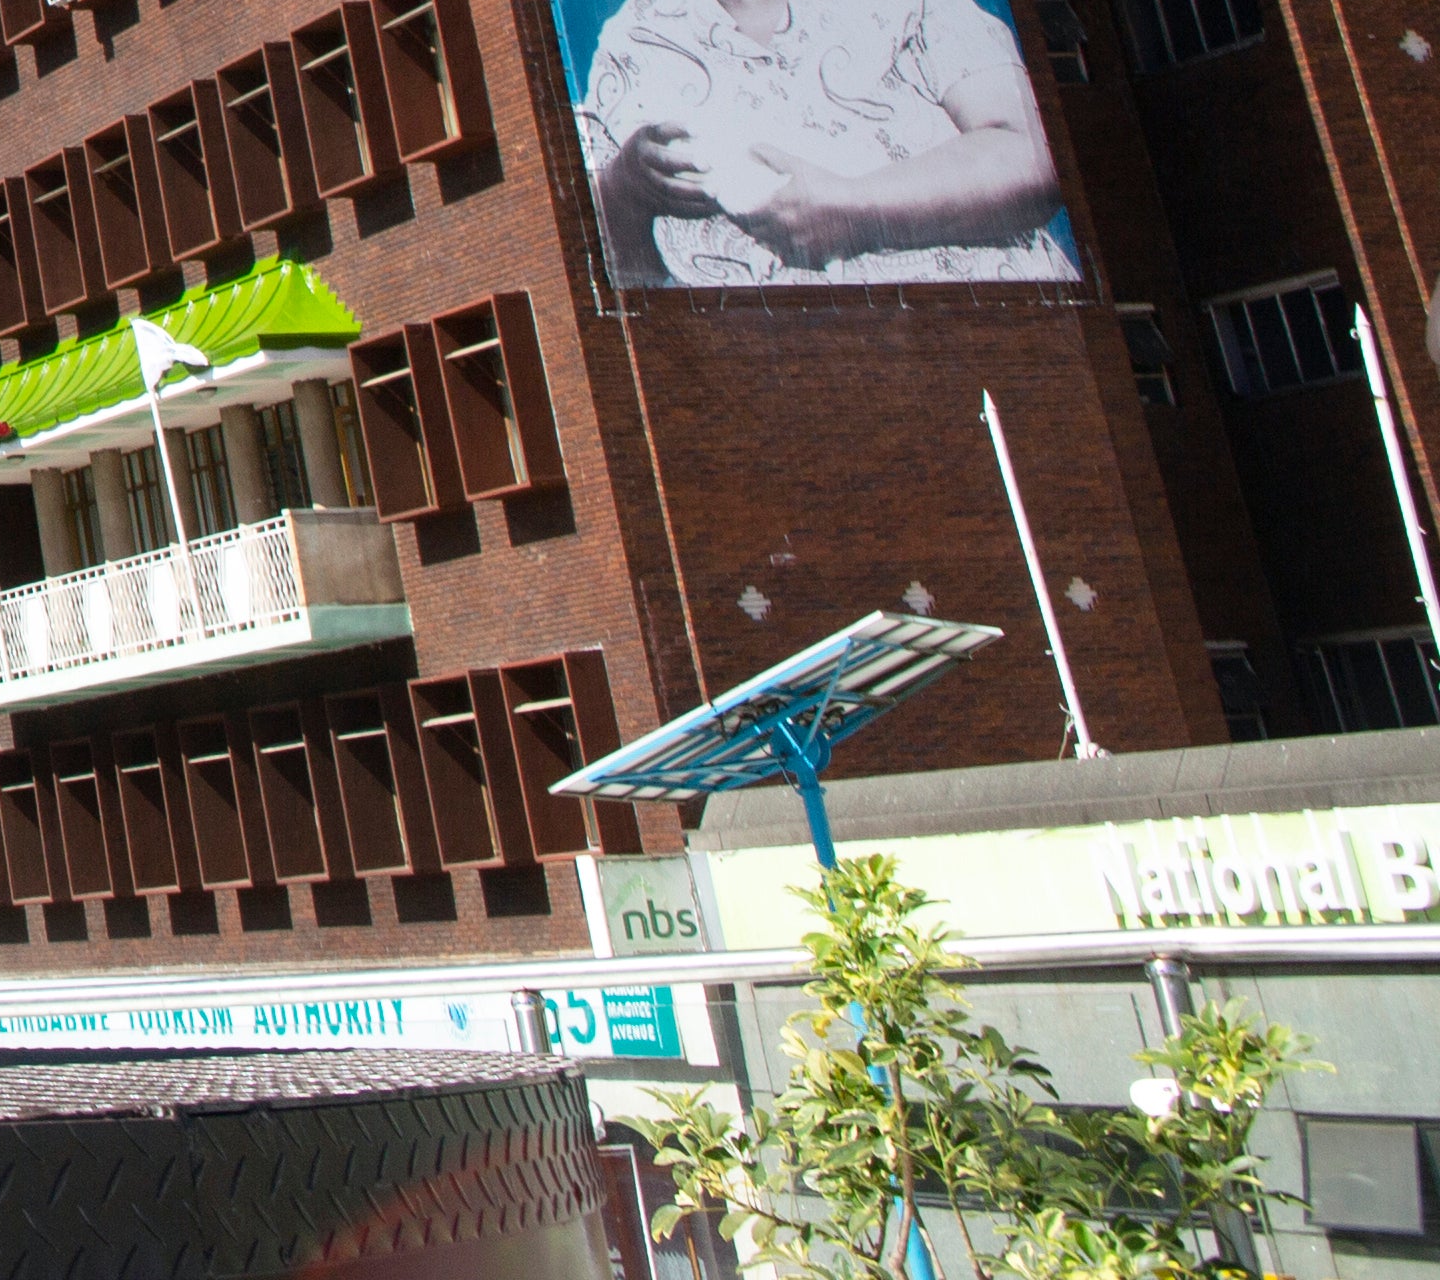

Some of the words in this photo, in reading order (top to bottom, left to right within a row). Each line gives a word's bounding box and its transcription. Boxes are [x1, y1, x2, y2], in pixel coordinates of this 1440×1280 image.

[1091, 826, 1370, 918] National
[1379, 836, 1440, 912] B
[622, 899, 698, 940] nbs
[255, 998, 404, 1036] AUTHORITY
[612, 1024, 656, 1041] AVENUE
